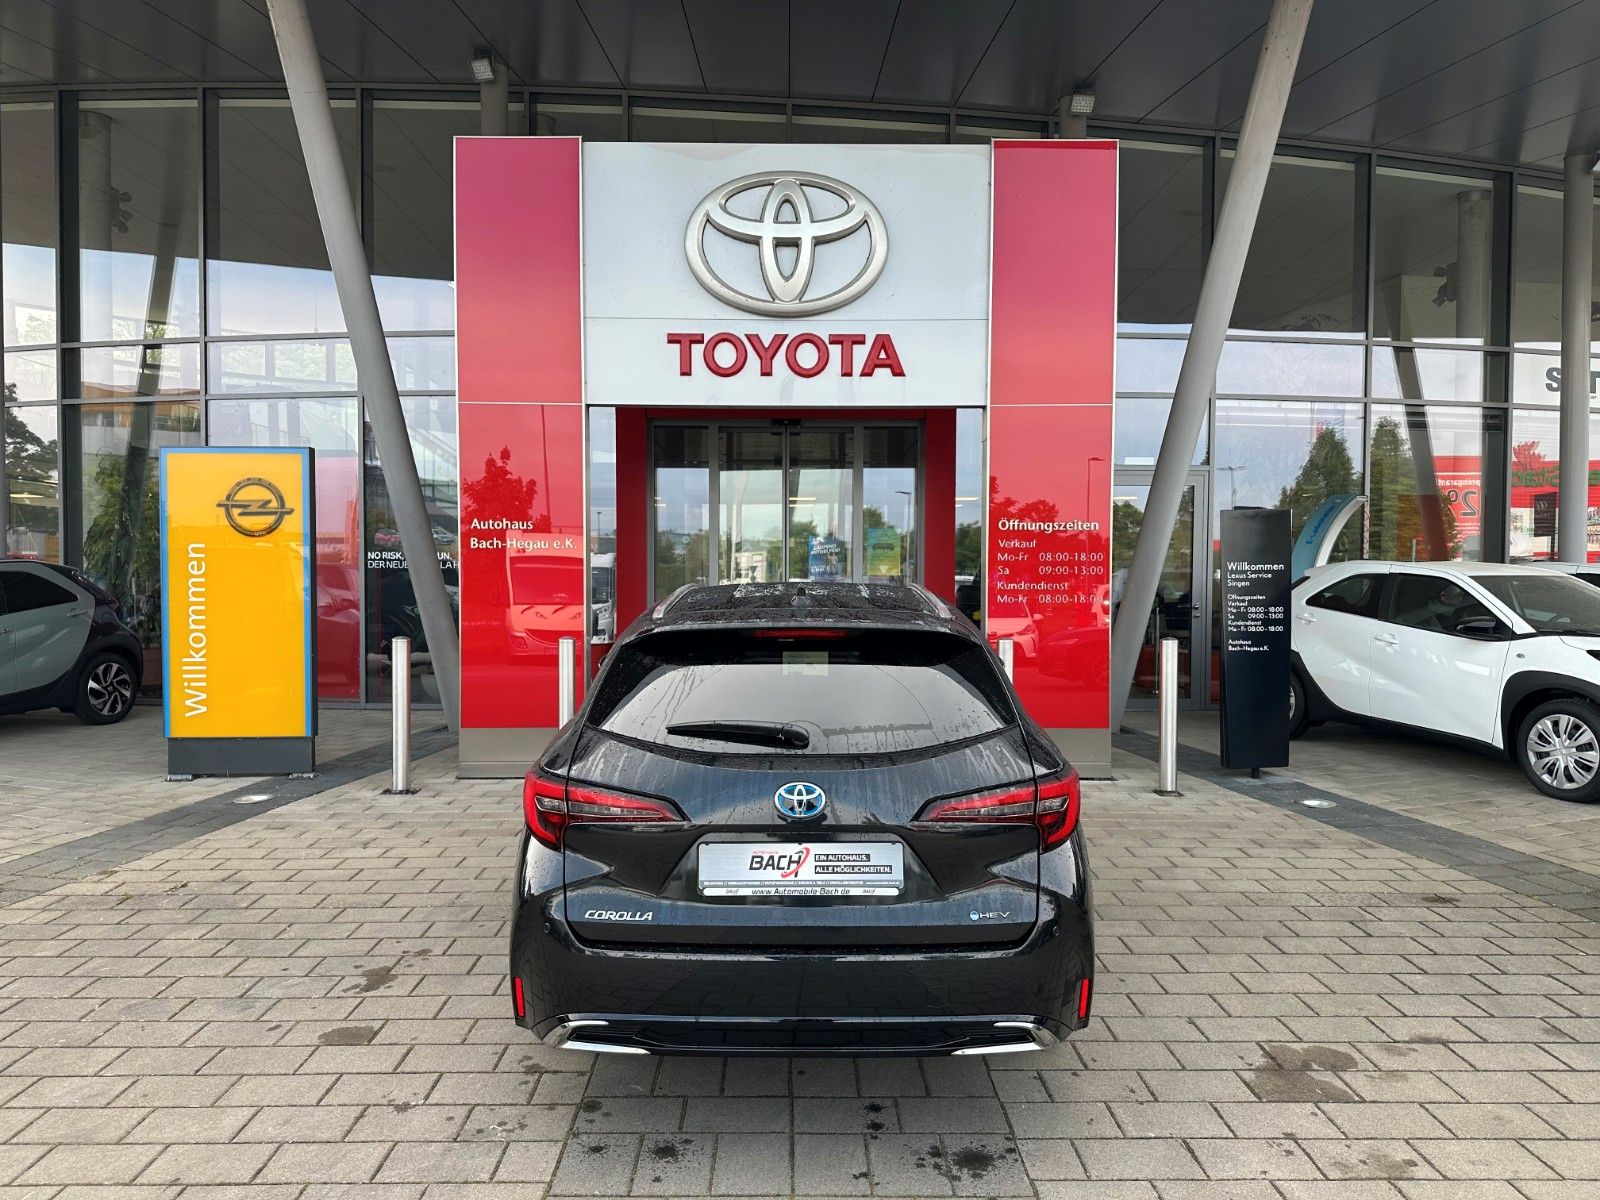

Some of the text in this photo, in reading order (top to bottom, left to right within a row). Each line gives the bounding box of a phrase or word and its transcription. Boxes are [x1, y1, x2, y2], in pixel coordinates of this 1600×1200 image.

[667, 333, 906, 378] TOYOTA
[470, 518, 534, 530] Autohaus
[998, 517, 1099, 533] Öffnungszeiten
[470, 537, 577, 551] Bach-Hegau e.K.
[998, 539, 1037, 548] Verkauf
[382, 552, 405, 560] RISK,
[997, 552, 1104, 561] Mo-Fr 08:00-18:00
[998, 566, 1104, 575] Sa 09:00-13:00
[1227, 562, 1285, 570] Willkommen
[997, 581, 1069, 590] Kundendienst
[997, 594, 1104, 603] Mo-Fr 08:00-18:00
[182, 543, 208, 717] Willkommen
[749, 851, 803, 874] BACH
[834, 865, 892, 873] MÖGLICHKEITEN.
[584, 910, 653, 921] COROLLA
[979, 911, 1010, 919] HEV
